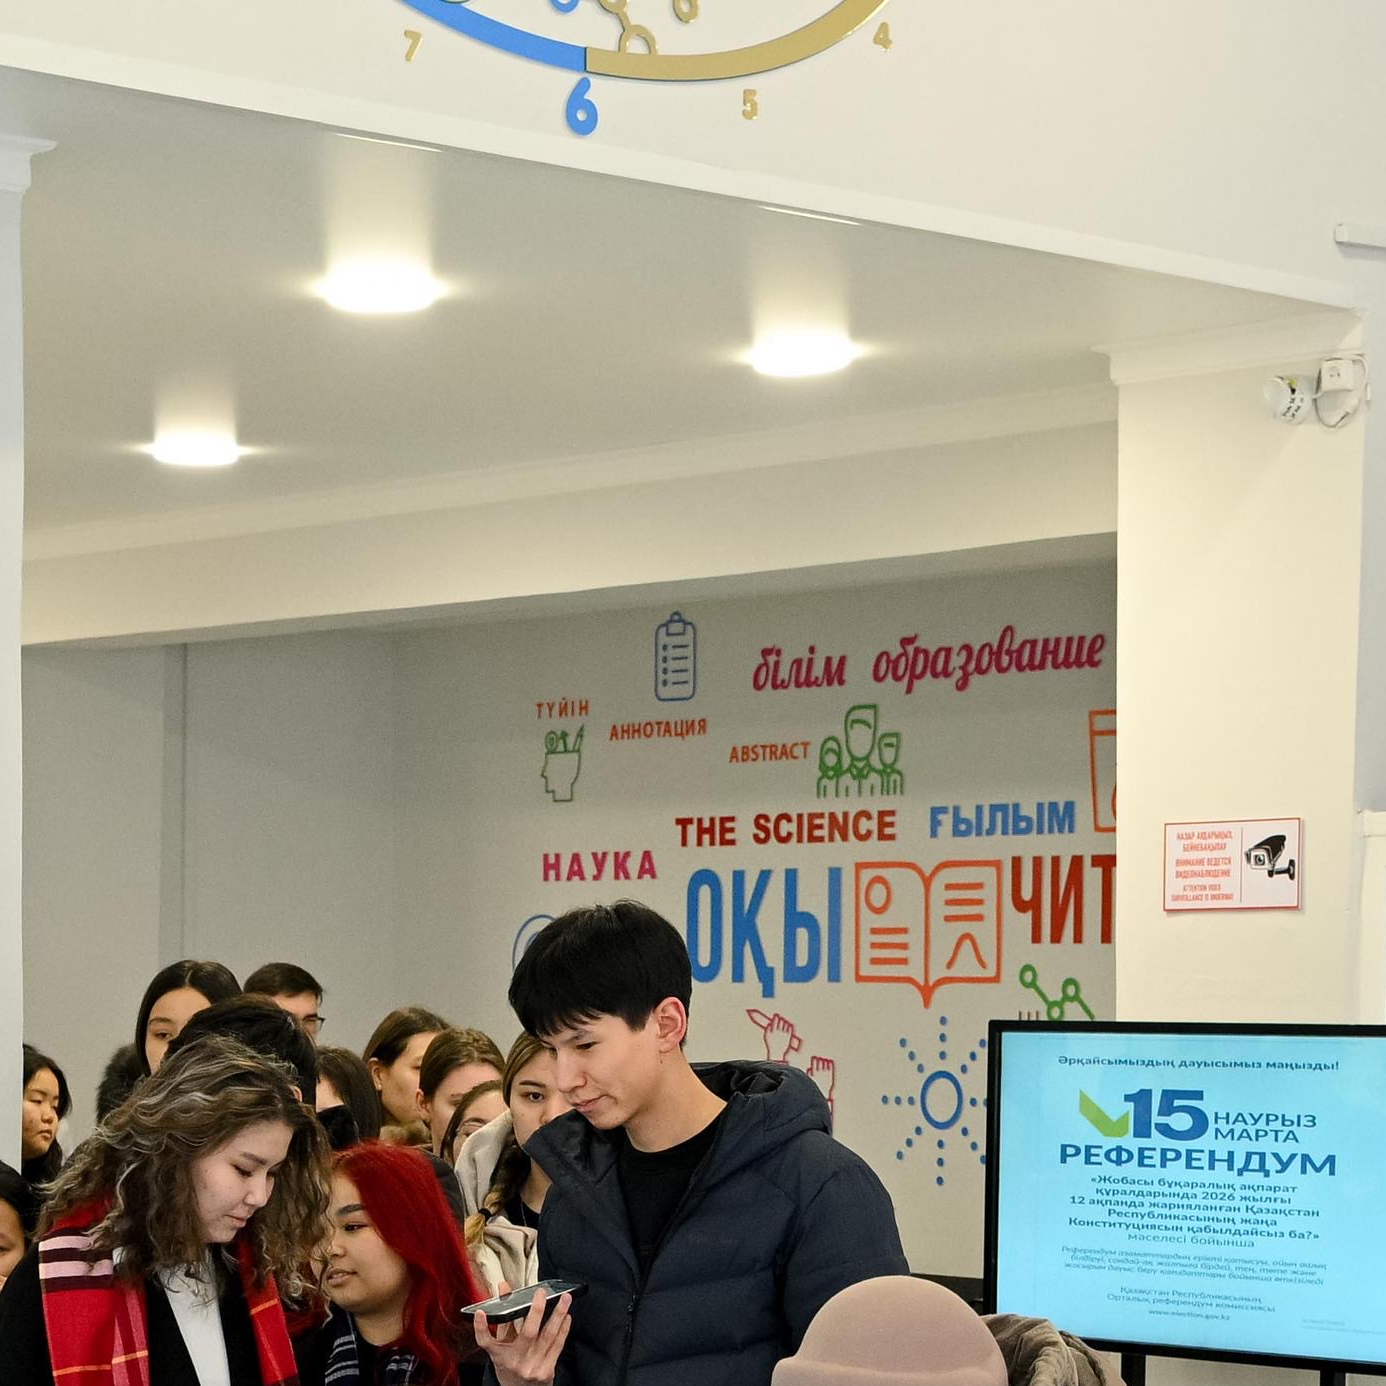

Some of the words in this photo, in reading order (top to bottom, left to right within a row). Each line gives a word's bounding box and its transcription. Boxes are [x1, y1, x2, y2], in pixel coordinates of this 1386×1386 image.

[403, 30, 423, 62] 7
[872, 22, 893, 53] 4
[565, 77, 598, 136] 6
[741, 89, 759, 120] 5
[872, 625, 1106, 695] образование
[608, 718, 707, 741] АННОТАЦИЯ
[729, 742, 810, 764] ABSTRACT
[675, 816, 737, 848] THE
[752, 810, 897, 844] SCIENCE
[542, 850, 658, 882] НАУКА
[686, 866, 842, 998] ОҚЫ
[1058, 1055, 1175, 1068] Әрқайсымыздың
[1178, 1059, 1262, 1070] дауысымыз
[1266, 1061, 1339, 1072] маңызды!
[1123, 1088, 1209, 1141] 15
[1214, 1111, 1317, 1128] НАУРЫЗ
[1214, 1128, 1300, 1143] МАРТА
[1059, 1144, 1336, 1177] РЕФЕРЕНДУМ
[1202, 1191, 1235, 1201] 2026
[1240, 1195, 1291, 1204] жылғы
[1240, 1183, 1298, 1193] ақпарат
[1070, 1195, 1085, 1205] 12
[1088, 1199, 1145, 1209] ақпанда
[1148, 1202, 1241, 1213] жарияланған
[1245, 1204, 1320, 1217] Қазақстан
[1108, 1208, 1236, 1225] Республикасының
[1240, 1217, 1277, 1227] жаңа
[1068, 1217, 1183, 1232] Конституциясын
[1187, 1225, 1285, 1238] қабылдайсыз
[1191, 1236, 1254, 1248] бойынша
